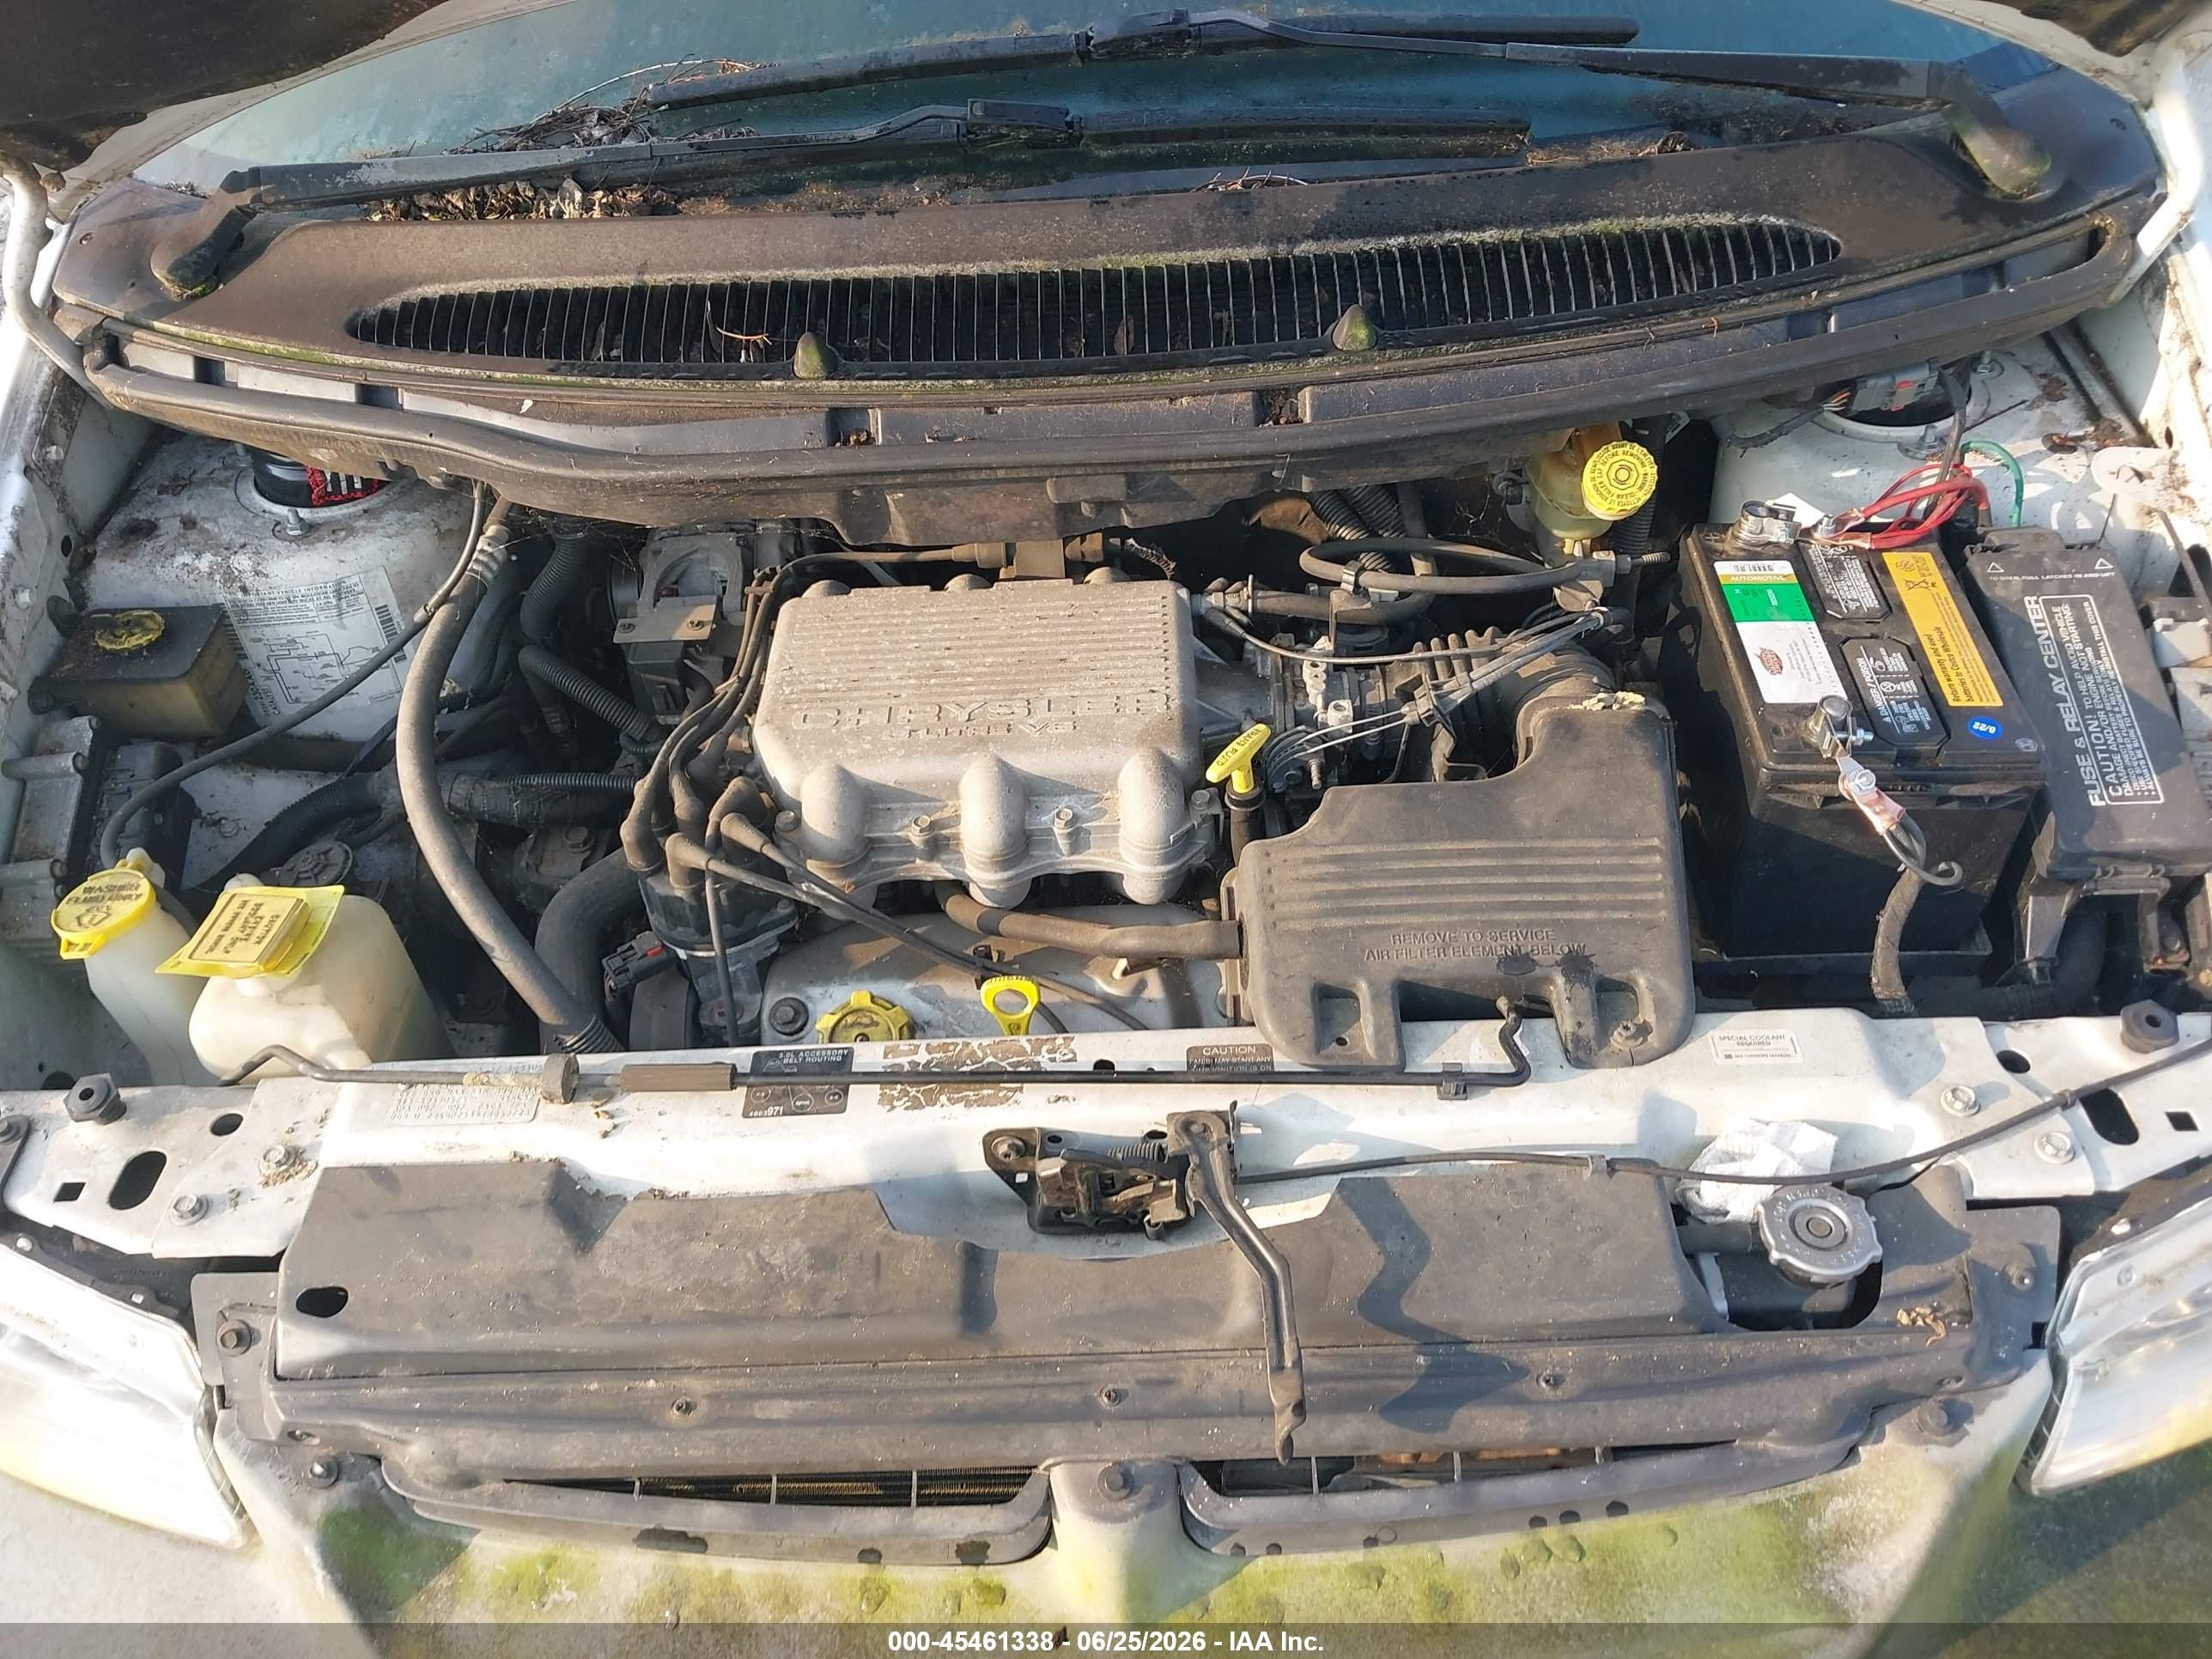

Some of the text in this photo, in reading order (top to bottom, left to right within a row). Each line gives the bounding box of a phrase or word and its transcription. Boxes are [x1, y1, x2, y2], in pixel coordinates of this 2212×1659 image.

[1599, 449, 1620, 466] BEFORE
[1622, 448, 1647, 469] REMOVING
[2082, 600, 2095, 623] COVER
[1923, 633, 1937, 647] used
[1932, 625, 1953, 653] Wholesale
[1855, 657, 1874, 682] POISON
[1935, 658, 1954, 682] warranty
[1944, 653, 1960, 671] Costco
[1954, 677, 1975, 702] batteries
[2024, 595, 2105, 805] FUSE & RELAY CENTER
[2051, 605, 2122, 797] CAUTION! TO HELP AVOID VEHICLE
[2060, 603, 2133, 796] DAMAGE AND/OR ENGINE NOT STARTING:
[793, 692, 1174, 730] CHRYSLER
[1869, 688, 1888, 715] DANGER
[1390, 928, 1556, 945] REMOVE TO SERVICE
[1364, 943, 1587, 962] AIR FILTER ELEMENT BELOW
[783, 1056, 803, 1065] BELT
[799, 1048, 849, 1057] ACCESSORY
[1202, 1045, 1256, 1056] CAUTION
